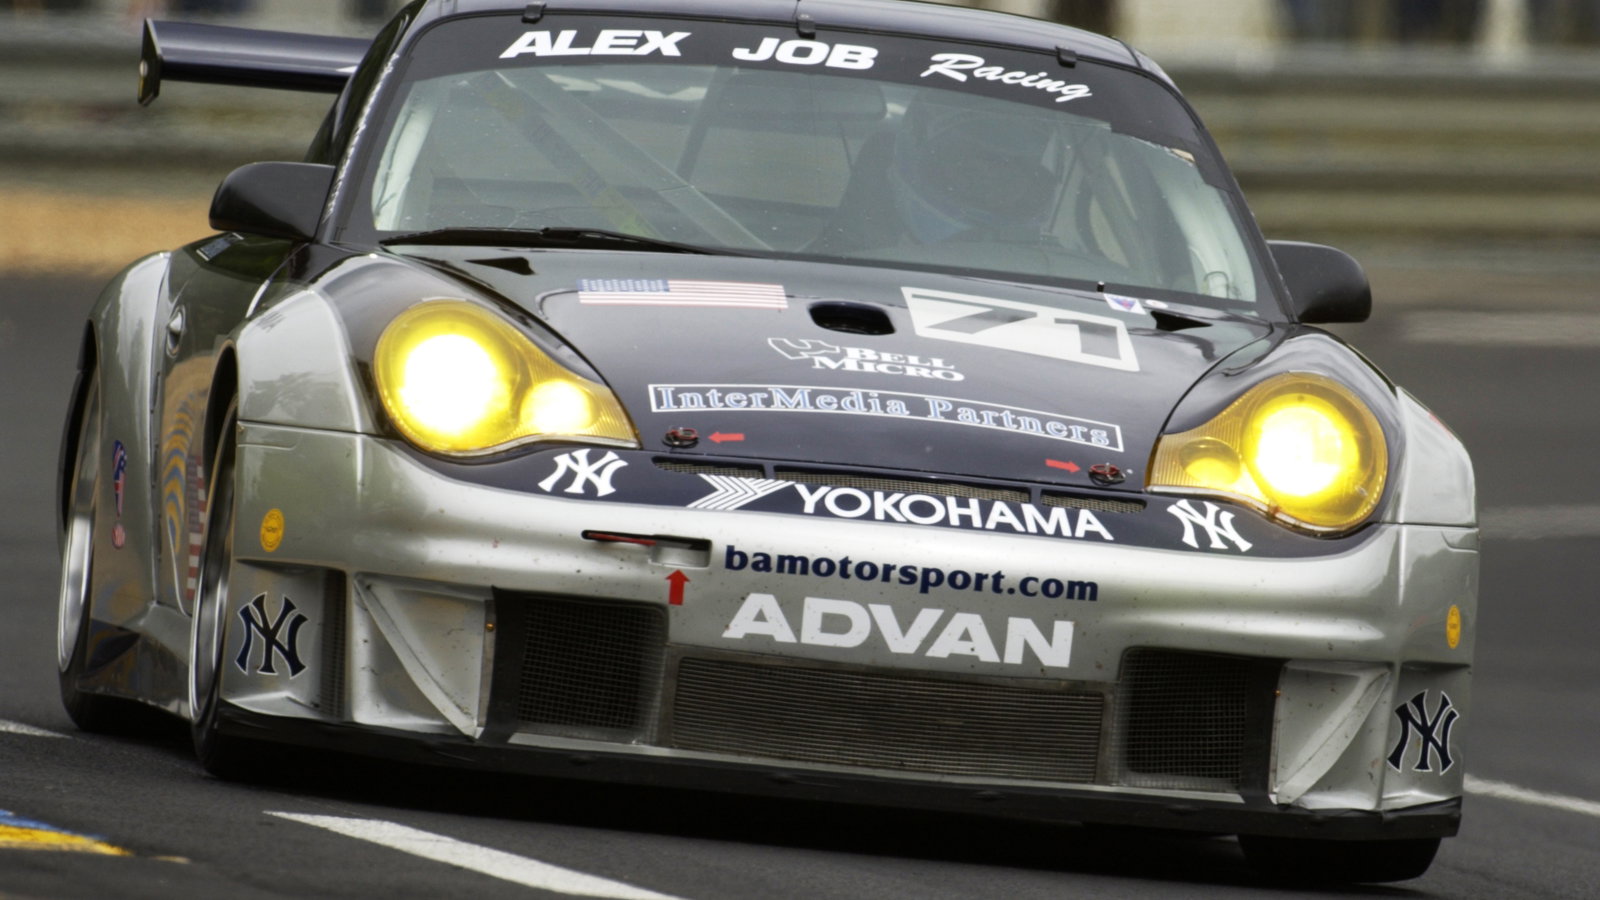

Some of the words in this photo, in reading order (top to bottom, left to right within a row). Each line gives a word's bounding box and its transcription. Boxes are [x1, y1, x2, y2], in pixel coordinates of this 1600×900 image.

[500, 29, 691, 58] ALEX
[732, 37, 878, 69] JOB
[921, 53, 1092, 102] Racing
[911, 294, 1122, 360] 71
[657, 387, 910, 416] InterMedia
[924, 397, 1110, 447] Partners
[794, 484, 1113, 541] YOKOHAMA
[725, 545, 1099, 601] bamotorsport.com
[722, 594, 1075, 668] ADVAN
